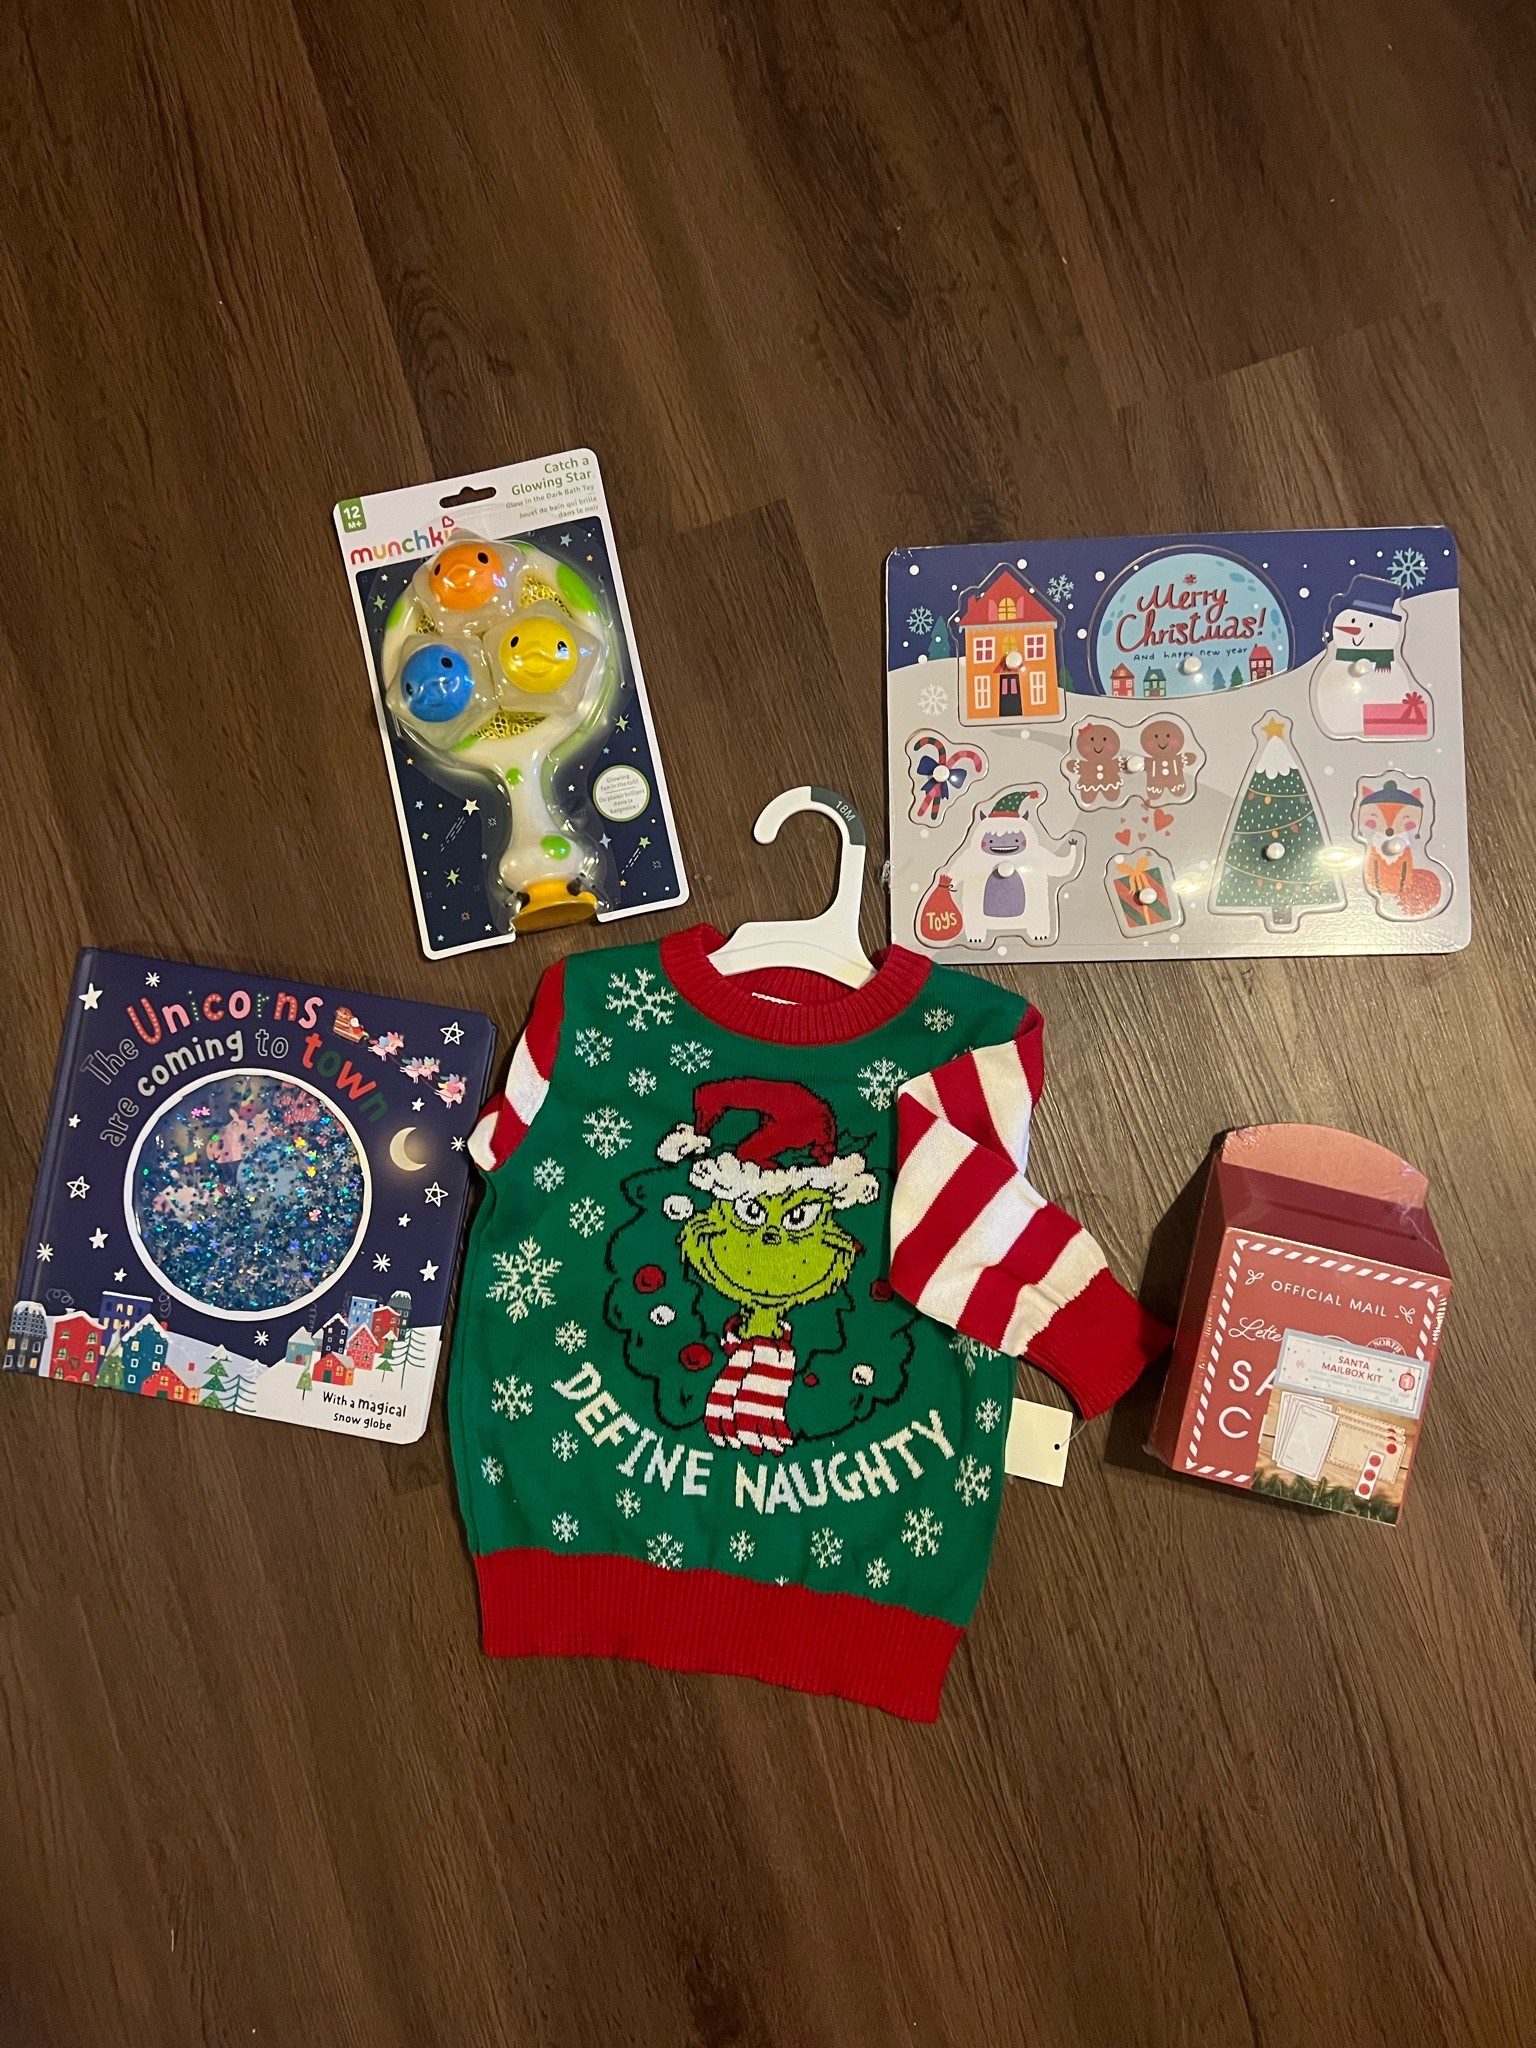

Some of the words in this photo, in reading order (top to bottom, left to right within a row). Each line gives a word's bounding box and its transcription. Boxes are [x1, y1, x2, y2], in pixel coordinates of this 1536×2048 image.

[544, 458, 579, 474] Catch
[582, 457, 589, 465] a
[511, 478, 563, 496] Glowing
[565, 470, 591, 483] Star
[505, 500, 524, 509] Glow
[533, 495, 545, 503] the
[546, 491, 563, 499] Dark
[564, 486, 581, 495] Bath
[582, 484, 594, 493] Toy
[343, 505, 361, 520] 12
[347, 520, 363, 530] M+
[350, 516, 461, 565] munchki
[1136, 583, 1229, 624] Merry
[1226, 647, 1248, 656] year
[835, 800, 856, 822] 18M
[925, 911, 958, 932] Toys
[81, 1037, 140, 1087] The
[126, 989, 324, 1045] Unicorns
[100, 1096, 140, 1148] are
[137, 1029, 244, 1097] coming
[254, 1028, 289, 1059] to
[302, 1032, 390, 1124] town
[1271, 1280, 1342, 1306] OFFICIAL
[1349, 1298, 1387, 1317] MAIL
[1228, 1316, 1284, 1342] Lette
[1372, 1339, 1402, 1353] NORTH
[1321, 1362, 1366, 1380] MAILBOX
[1366, 1373, 1383, 1384] KIT
[1338, 1355, 1370, 1371] SANTA
[323, 1390, 348, 1406] With
[349, 1399, 355, 1409] a
[357, 1398, 407, 1418] magical
[333, 1412, 362, 1425] snow
[363, 1417, 392, 1431] globe
[551, 1361, 714, 1497] DEFINE
[735, 1408, 956, 1515] NAUGHTY
